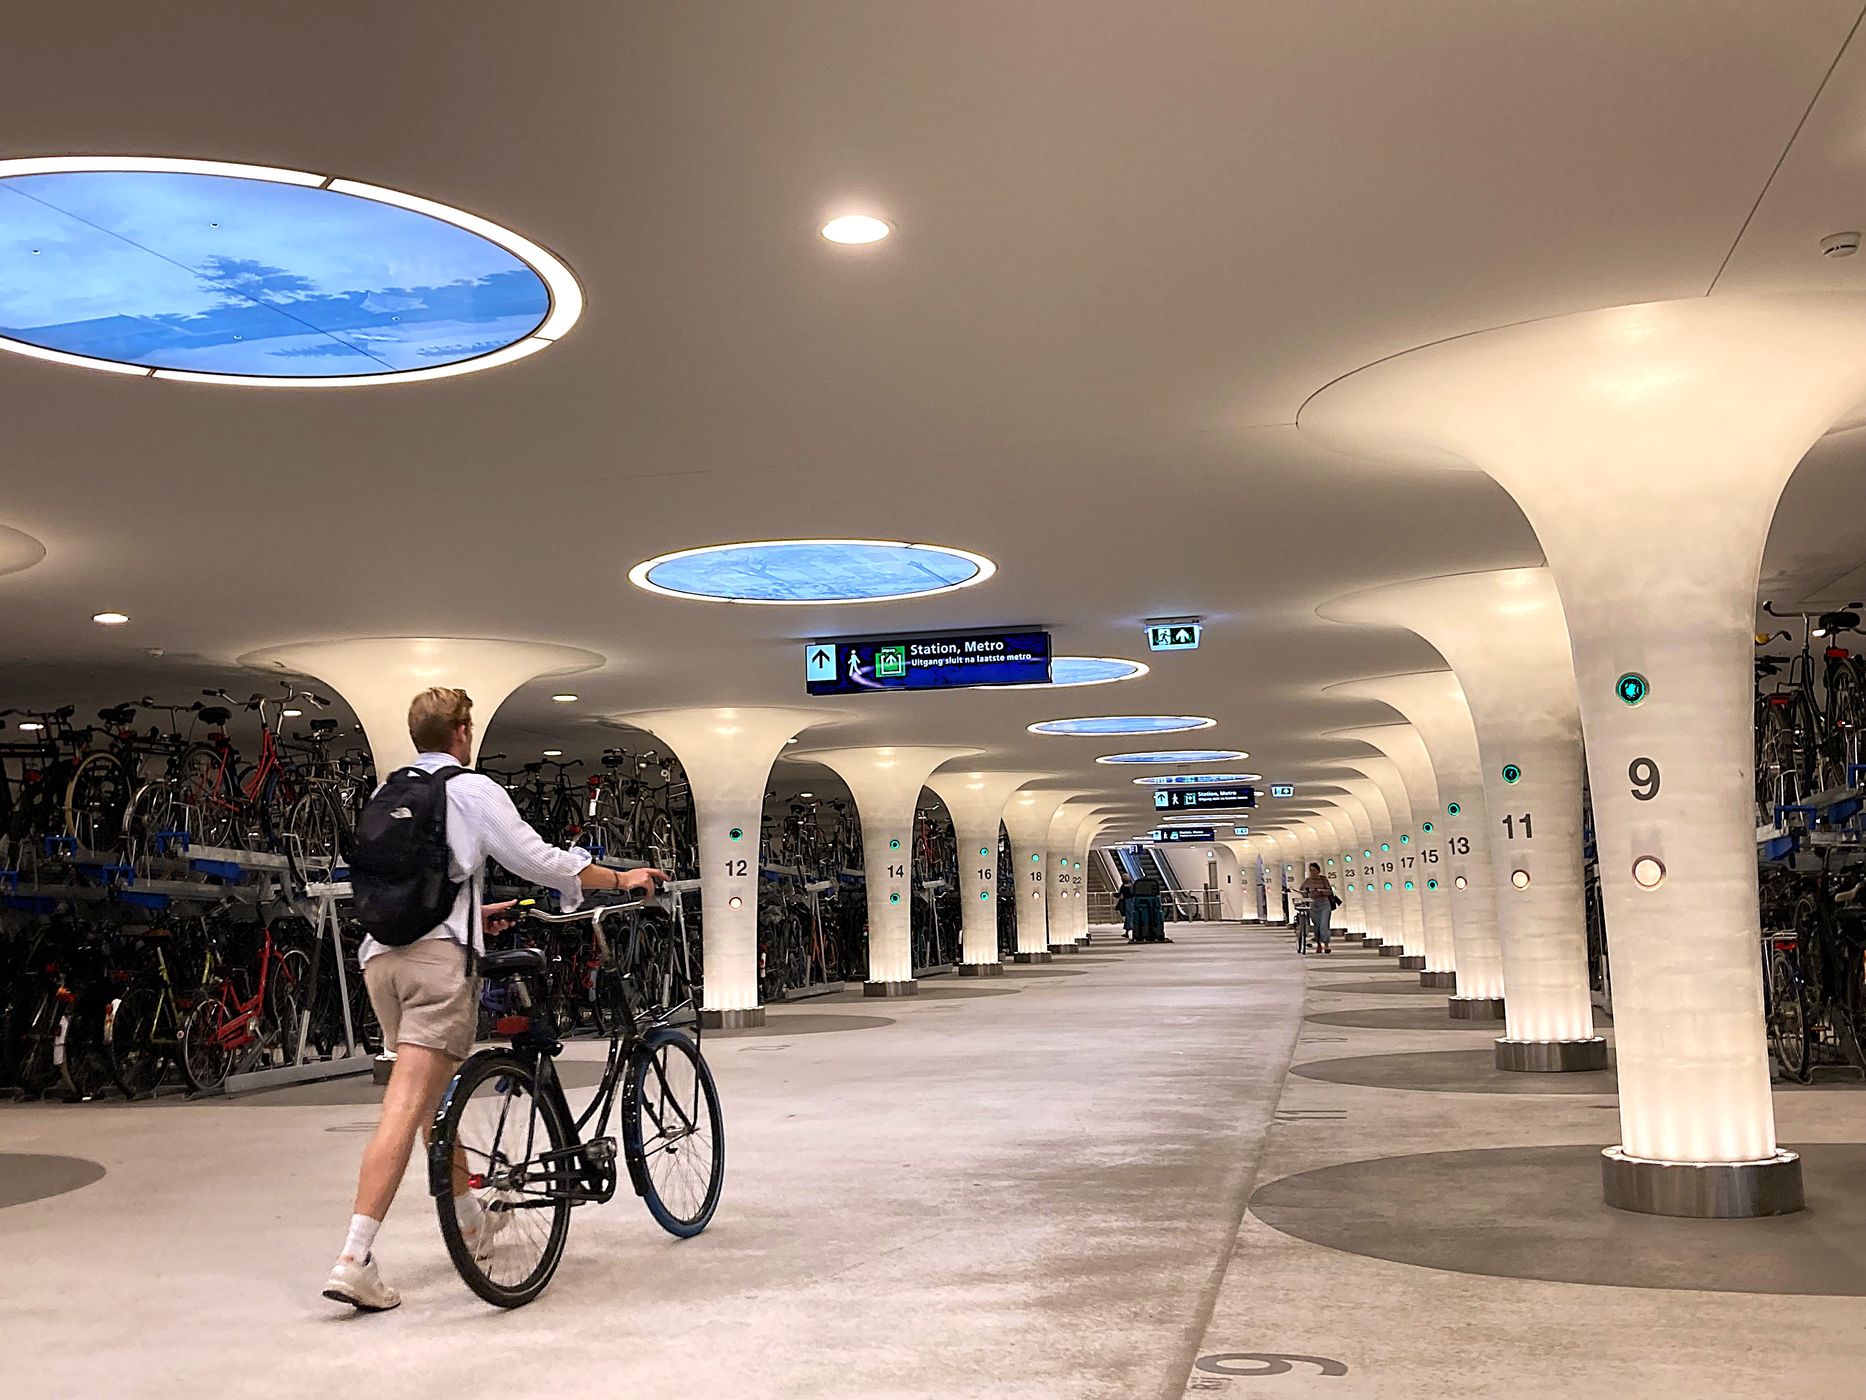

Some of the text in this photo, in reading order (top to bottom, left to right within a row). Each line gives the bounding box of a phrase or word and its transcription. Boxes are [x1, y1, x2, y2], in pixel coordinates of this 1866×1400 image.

[910, 641, 1004, 656] Station, Metro
[911, 653, 1032, 668] Uitgang sluit na laatste metro
[1628, 757, 1661, 801] 9
[1502, 813, 1533, 840] 11
[1448, 836, 1470, 855] 13
[1421, 849, 1439, 864] 15
[725, 859, 748, 877] 12
[1380, 862, 1394, 873] 19
[1400, 857, 1415, 869] 17
[887, 864, 905, 879] 14
[977, 868, 992, 880] 16
[1030, 871, 1042, 882] 18
[1327, 871, 1337, 879] 25
[1345, 869, 1356, 877] 23
[1364, 866, 1375, 876] 21
[1059, 874, 1070, 883] 20
[1072, 876, 1082, 885] 22
